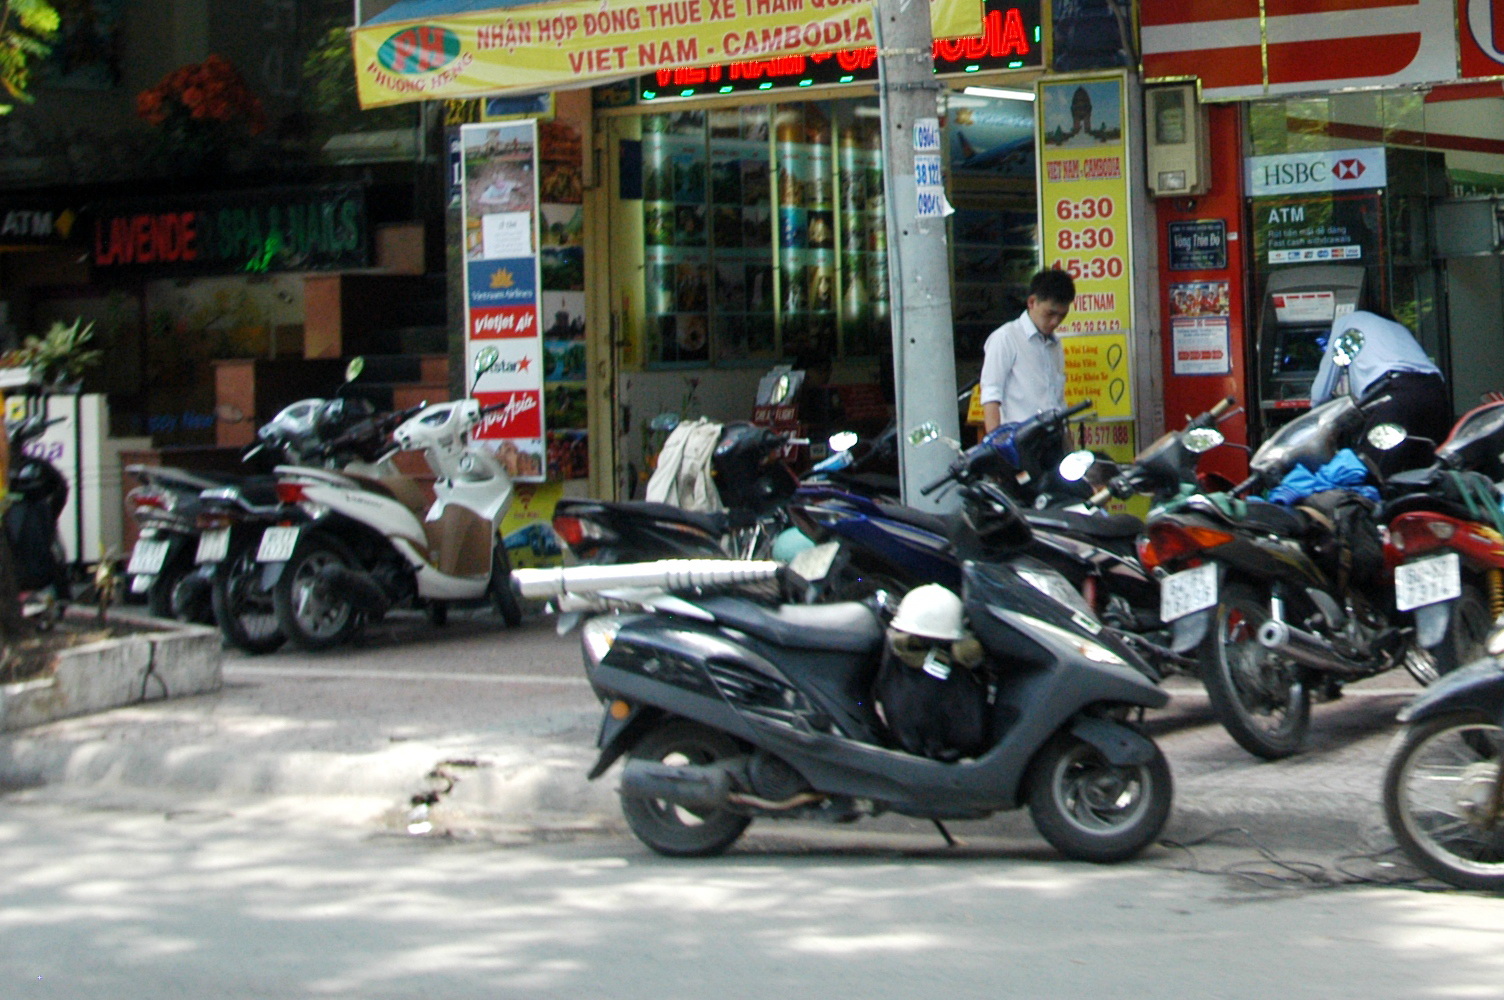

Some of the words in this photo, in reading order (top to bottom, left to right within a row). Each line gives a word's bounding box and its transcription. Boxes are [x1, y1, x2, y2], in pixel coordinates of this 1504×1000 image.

[477, 18, 531, 54] NHẬN
[568, 43, 627, 75] VIET
[638, 37, 697, 67] NAM
[722, 17, 873, 57] CAMBODIA
[1264, 161, 1327, 186] HSBC
[1056, 197, 1114, 222] 6:30
[1268, 206, 1305, 224] ATM
[2, 209, 53, 238] ATM
[1057, 226, 1115, 251] 8:30
